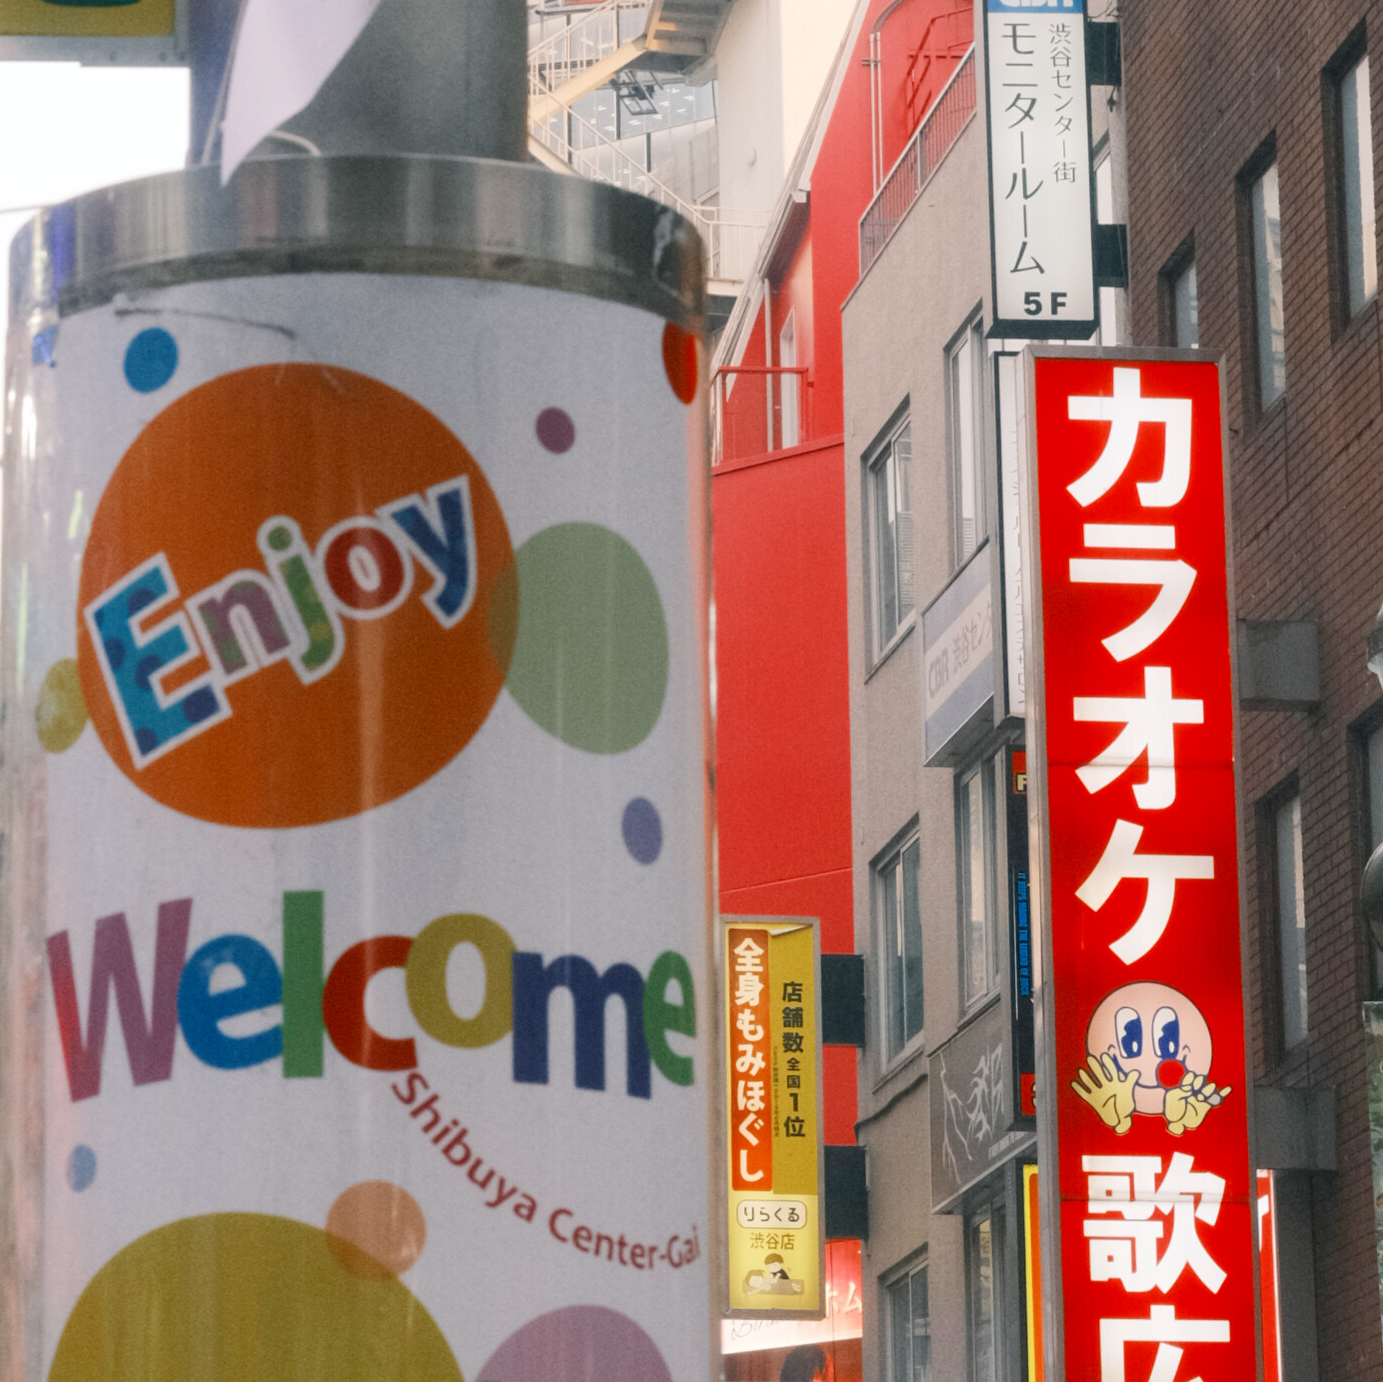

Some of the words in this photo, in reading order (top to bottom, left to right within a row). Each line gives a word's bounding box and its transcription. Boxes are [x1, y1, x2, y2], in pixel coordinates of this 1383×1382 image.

[1002, 22, 1045, 275] モニタールーム
[1048, 23, 1077, 184] 渋谷センター街
[1023, 292, 1068, 316] 5F
[83, 475, 477, 771] Enjoy
[1065, 366, 1215, 966] カラオケ
[45, 890, 697, 1104] Welcome
[732, 937, 767, 1184] 全身もみほぐし
[782, 980, 806, 1139] 店舗数全国1位
[391, 1070, 538, 1223] Shibuya
[743, 1205, 800, 1224] りらくる
[749, 1231, 796, 1251] 渋谷店
